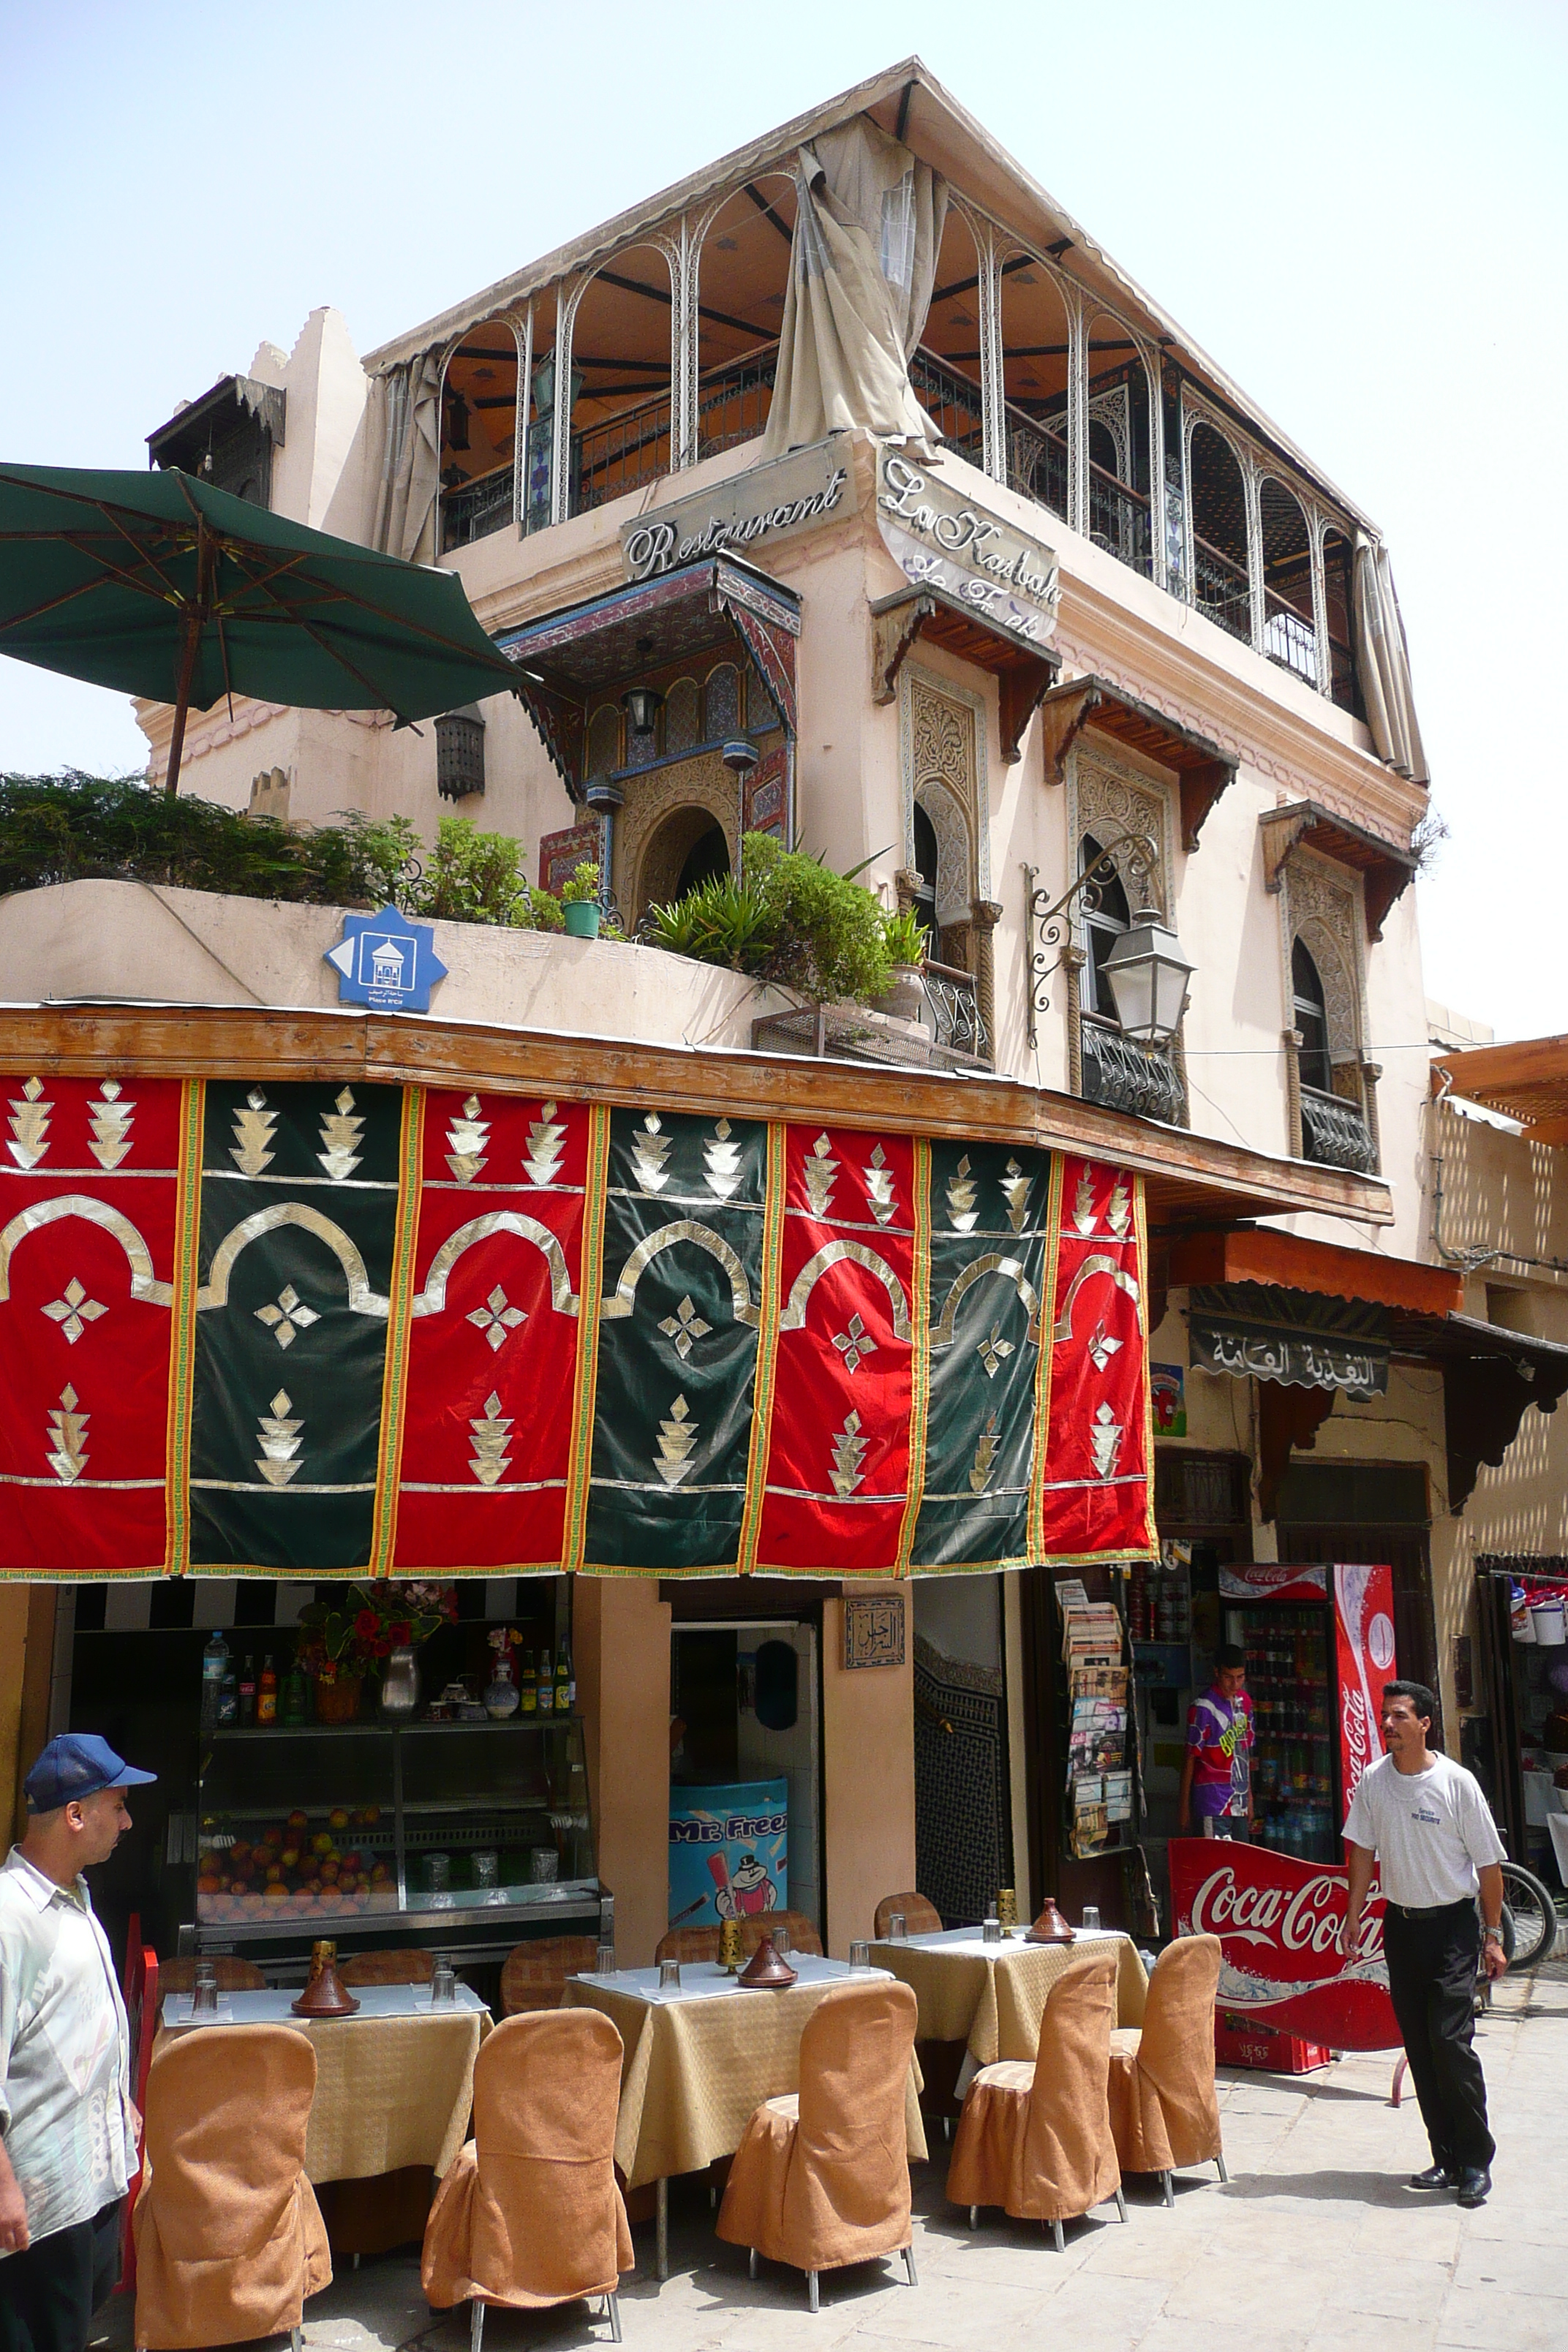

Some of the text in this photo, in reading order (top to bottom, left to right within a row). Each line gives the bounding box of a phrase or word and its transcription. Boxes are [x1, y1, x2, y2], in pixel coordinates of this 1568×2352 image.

[624, 468, 846, 583] Restaurant
[885, 458, 1063, 605] La Kasbah
[1301, 1343, 1376, 1387] التغذية
[1244, 1566, 1290, 1583] Coca-Cola
[668, 1819, 723, 1843] Mr.
